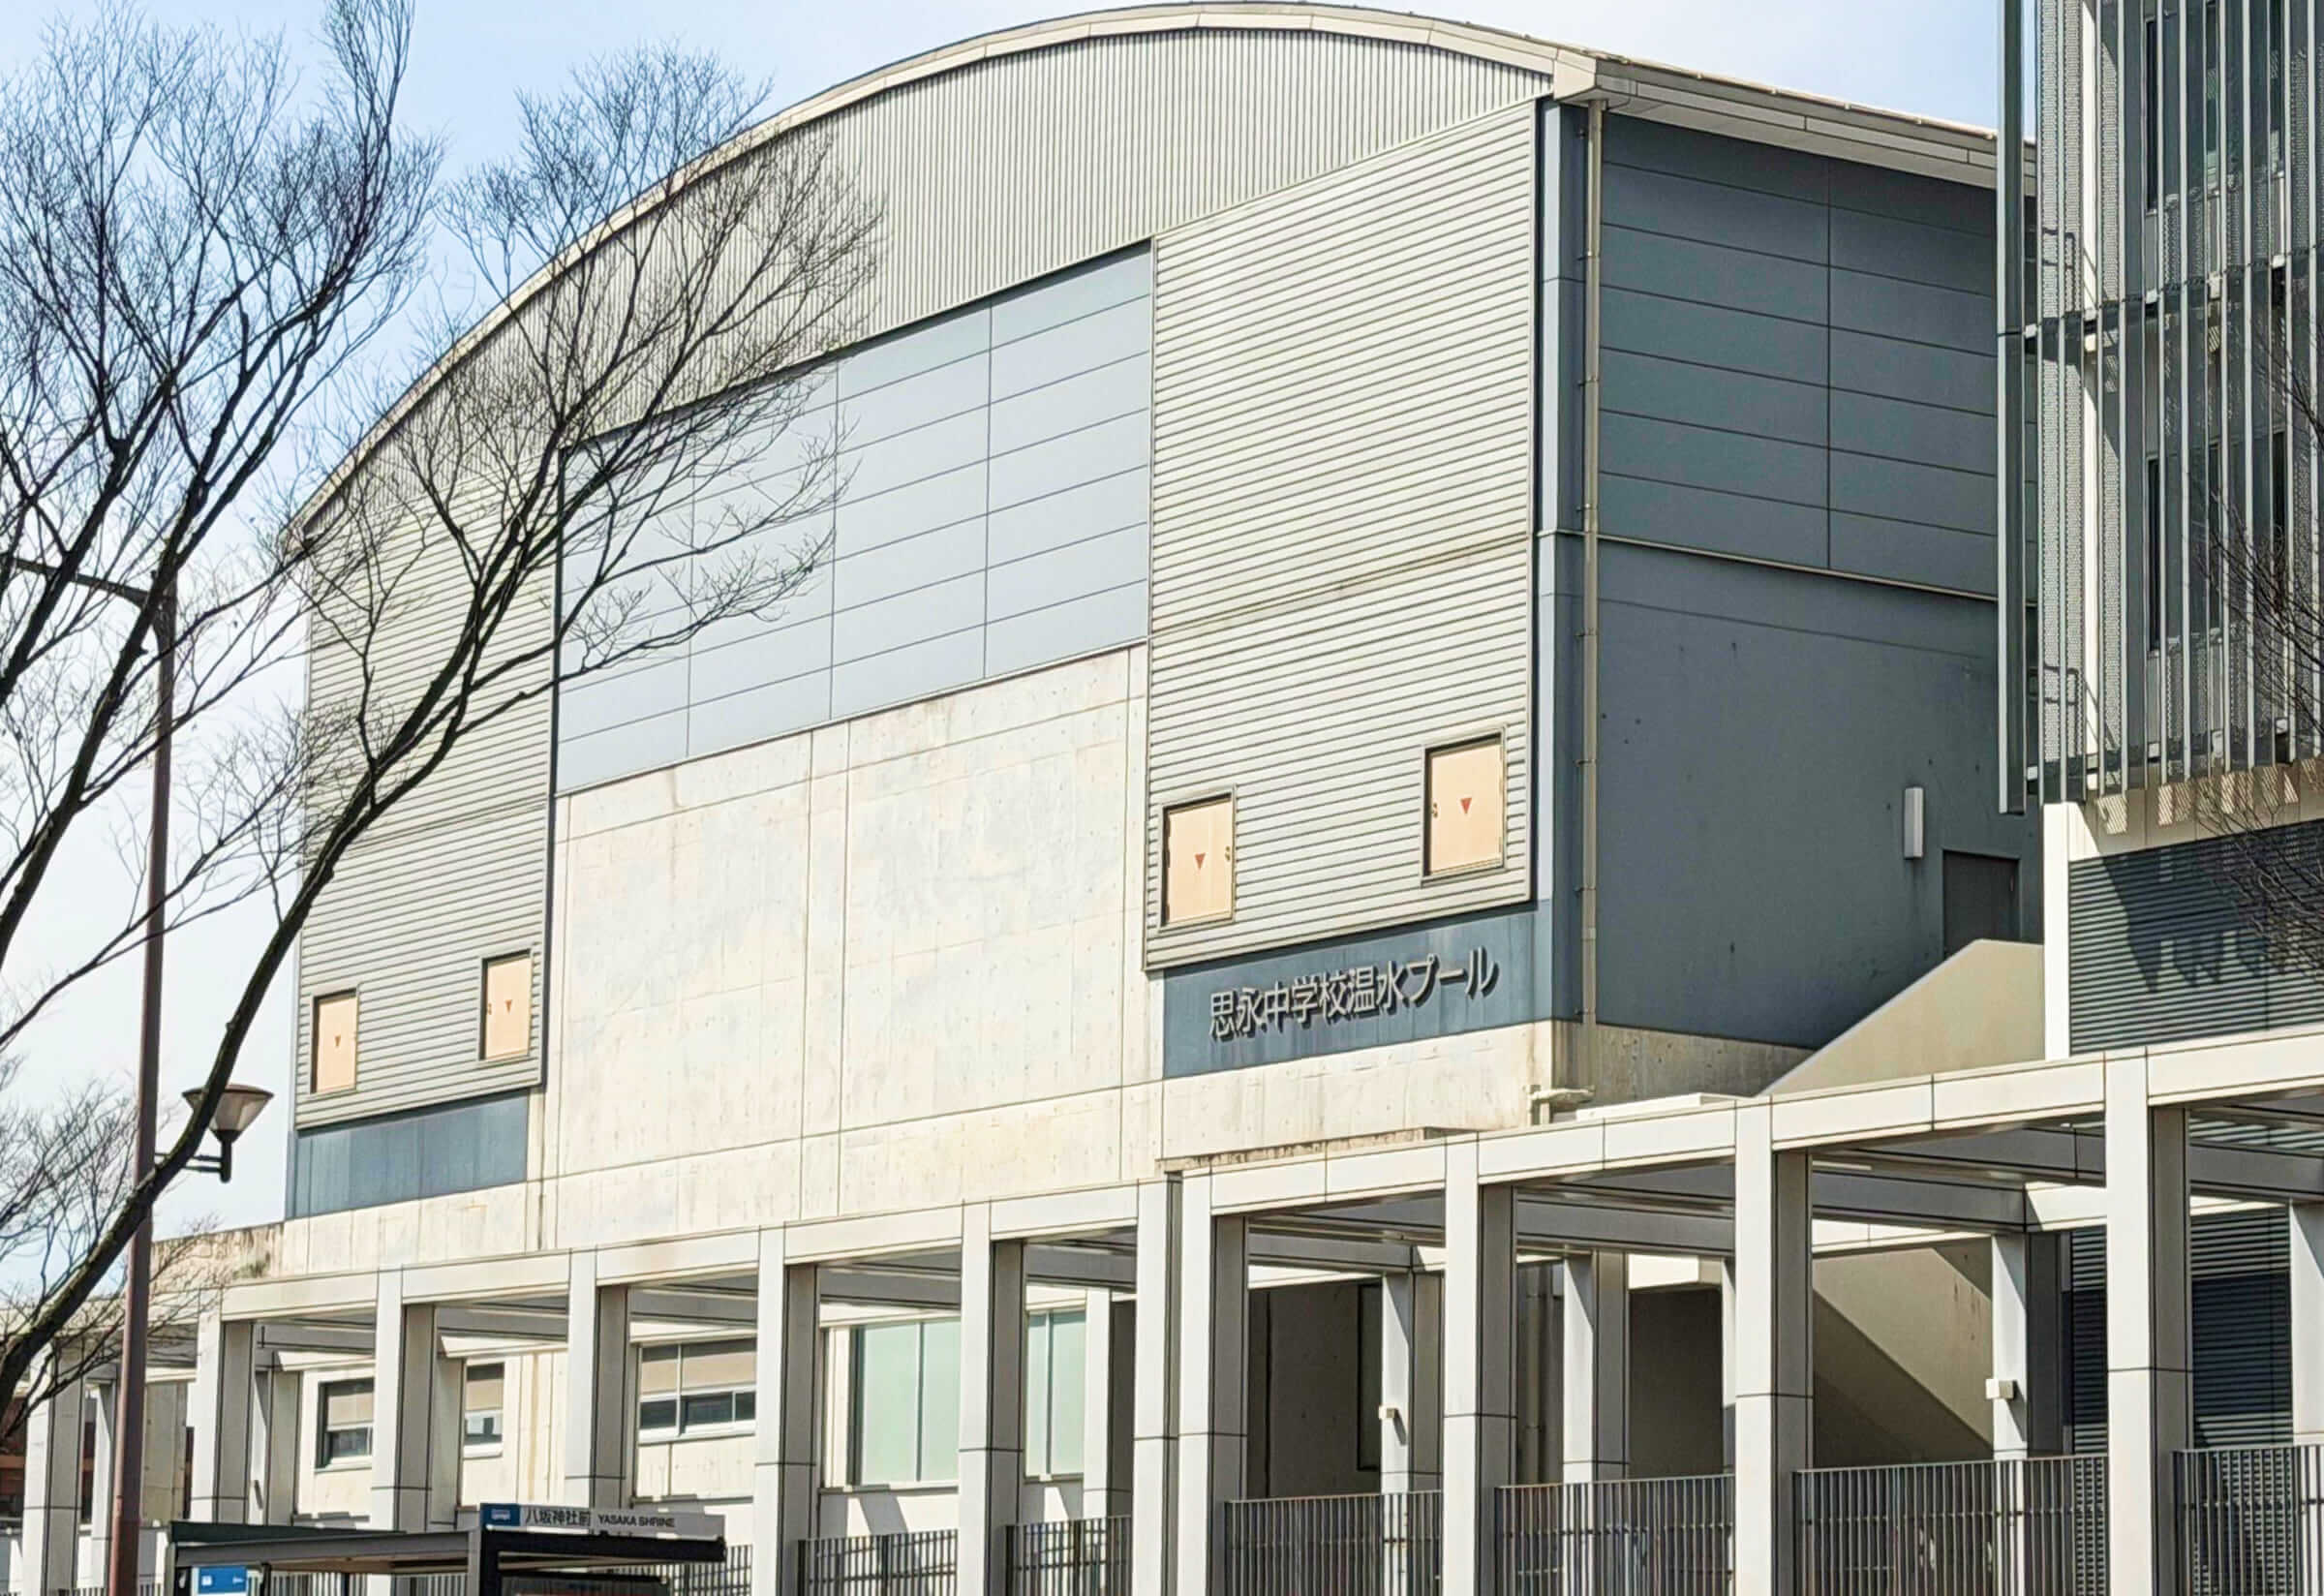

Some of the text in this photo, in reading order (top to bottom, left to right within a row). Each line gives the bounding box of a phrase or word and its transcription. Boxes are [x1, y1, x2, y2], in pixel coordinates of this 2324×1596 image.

[1209, 946, 1498, 1040] 思永中学校温水プール
[525, 1509, 591, 1526] 八坂神社前
[597, 1514, 675, 1527] YASAKA SHRINE
